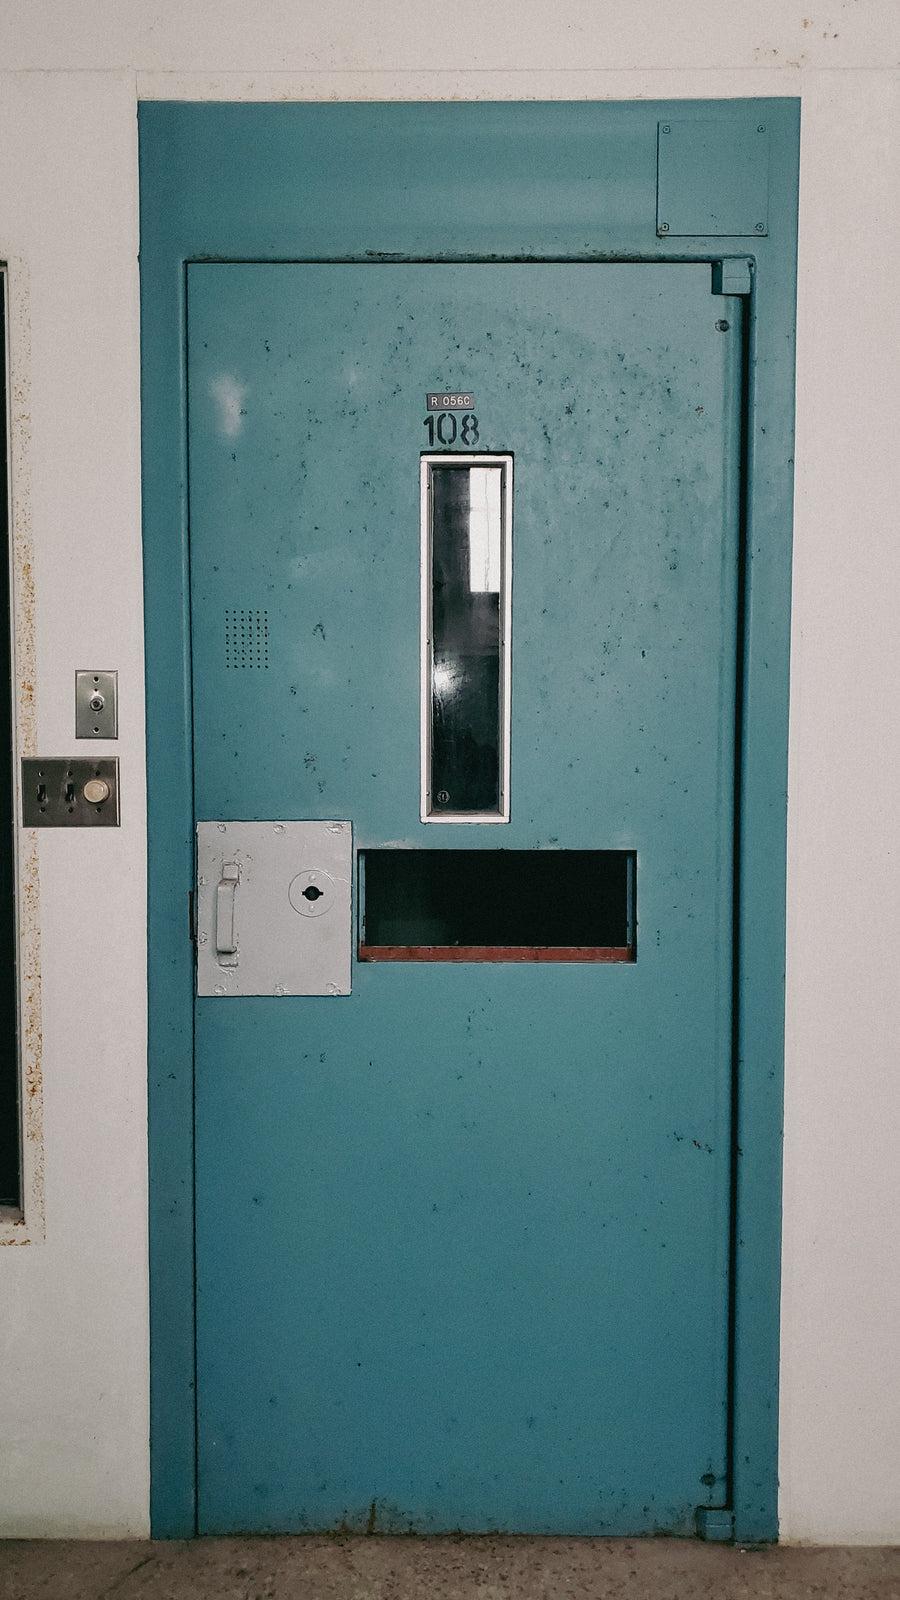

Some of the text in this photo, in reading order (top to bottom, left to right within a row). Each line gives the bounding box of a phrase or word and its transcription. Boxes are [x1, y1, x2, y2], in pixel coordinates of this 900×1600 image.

[431, 396, 470, 406] R 056C
[423, 413, 480, 447] 108
